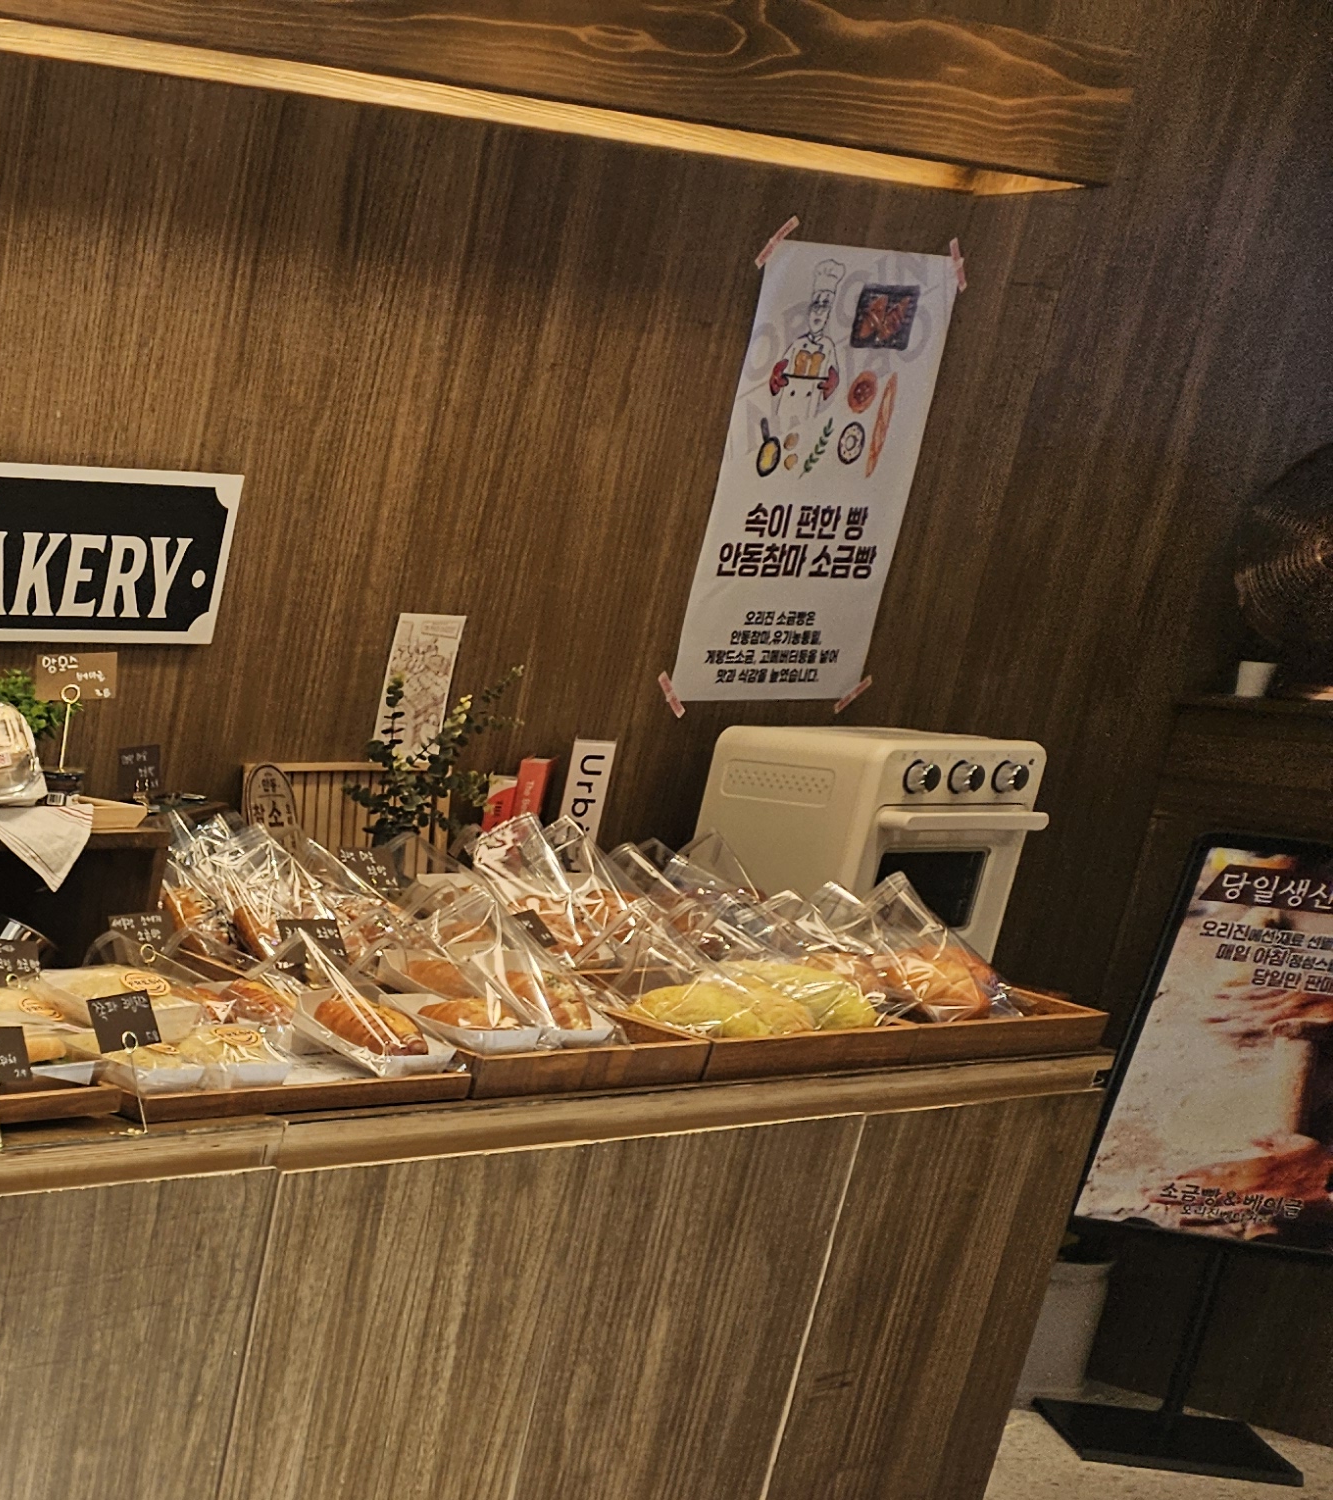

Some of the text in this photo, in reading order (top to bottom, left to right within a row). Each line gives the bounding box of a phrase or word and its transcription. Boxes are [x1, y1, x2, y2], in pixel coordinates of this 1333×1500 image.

[744, 502, 869, 541] 속이 편한 빵
[716, 542, 877, 580] 안동참마 소금빵
[744, 610, 816, 627] 오리진 소금빵은
[1215, 943, 1333, 972] 매일 아침 정성스
[1251, 968, 1302, 990] 당일만
[1160, 1182, 1305, 1220] 소금빵 & 베이글
